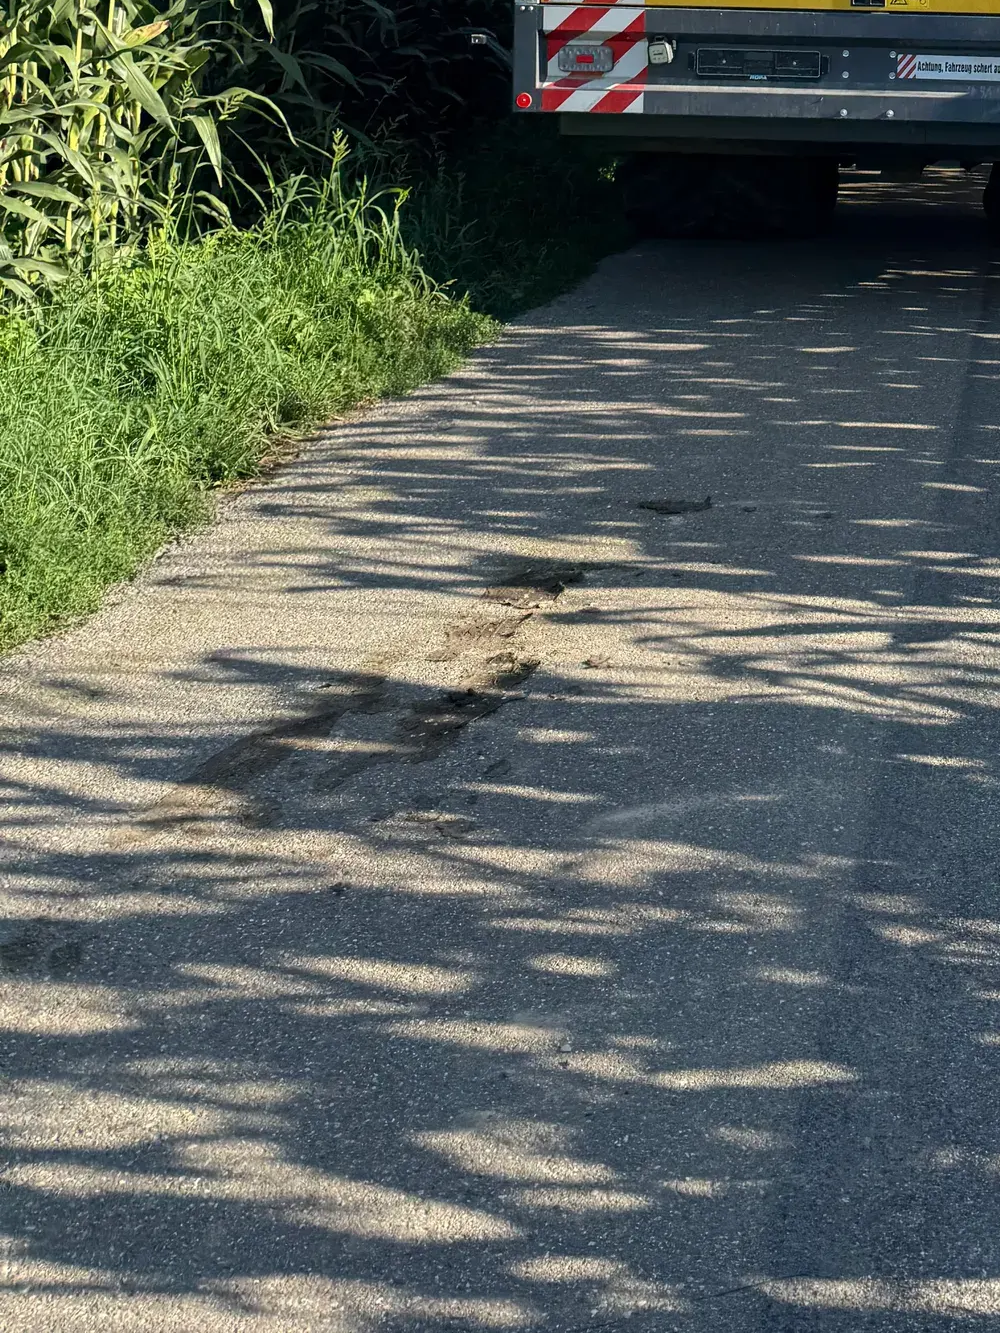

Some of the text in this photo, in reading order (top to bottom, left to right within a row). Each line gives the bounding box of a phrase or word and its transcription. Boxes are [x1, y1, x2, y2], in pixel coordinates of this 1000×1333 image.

[917, 61, 944, 74] Achtung,
[945, 62, 972, 75] Fahrzeug
[974, 64, 993, 74] schert
